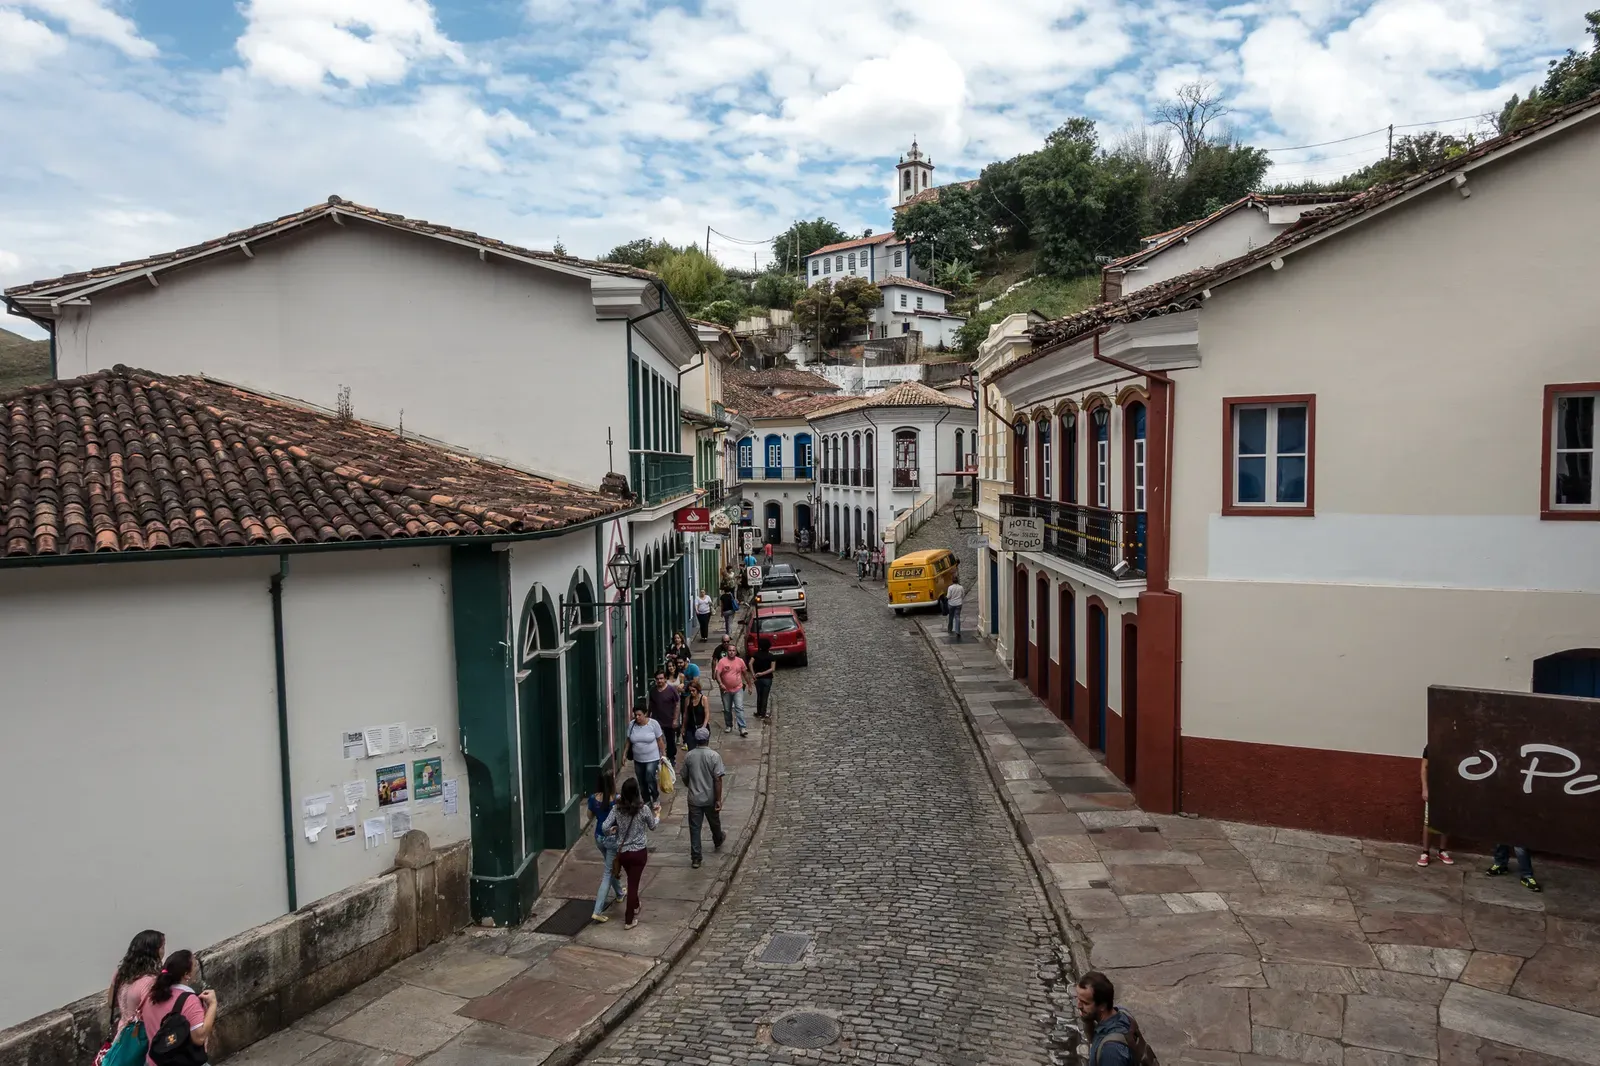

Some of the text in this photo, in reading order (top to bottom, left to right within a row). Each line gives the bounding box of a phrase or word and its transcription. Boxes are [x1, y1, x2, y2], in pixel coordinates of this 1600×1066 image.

[1009, 519, 1037, 530] HOTEL
[1004, 536, 1041, 548] TOFFOLO
[896, 569, 921, 577] SEDEX
